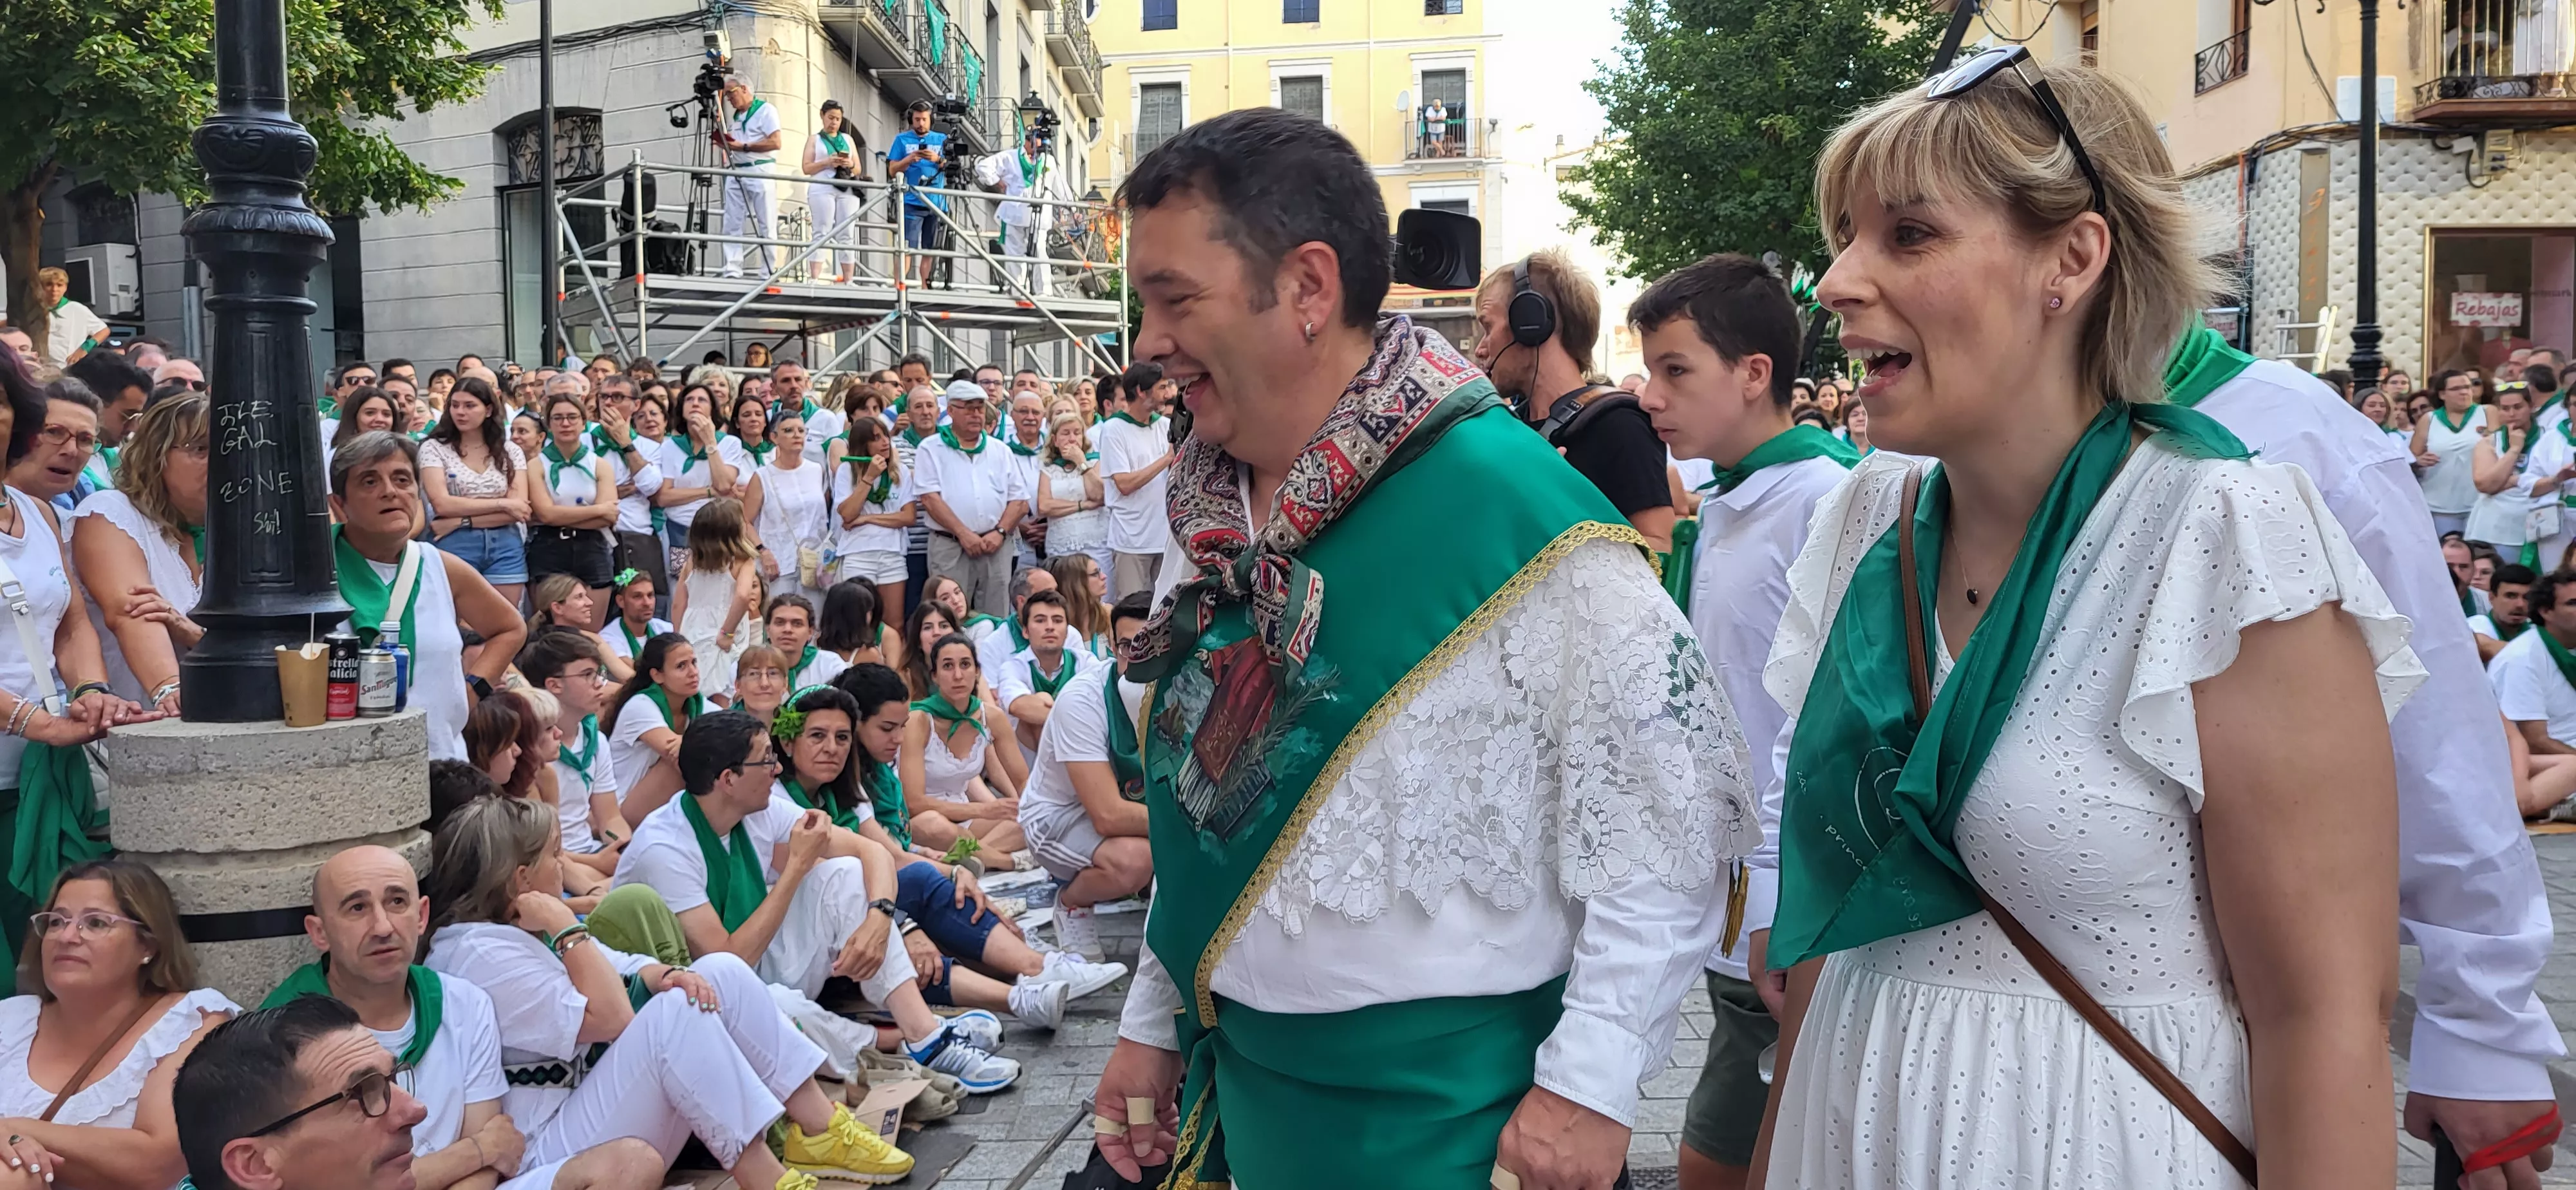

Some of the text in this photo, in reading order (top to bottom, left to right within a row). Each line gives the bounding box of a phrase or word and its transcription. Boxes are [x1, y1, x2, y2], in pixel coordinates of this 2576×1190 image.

[2456, 299, 2519, 321] Rebajas
[329, 657, 359, 668] strella
[330, 668, 357, 679] alicia
